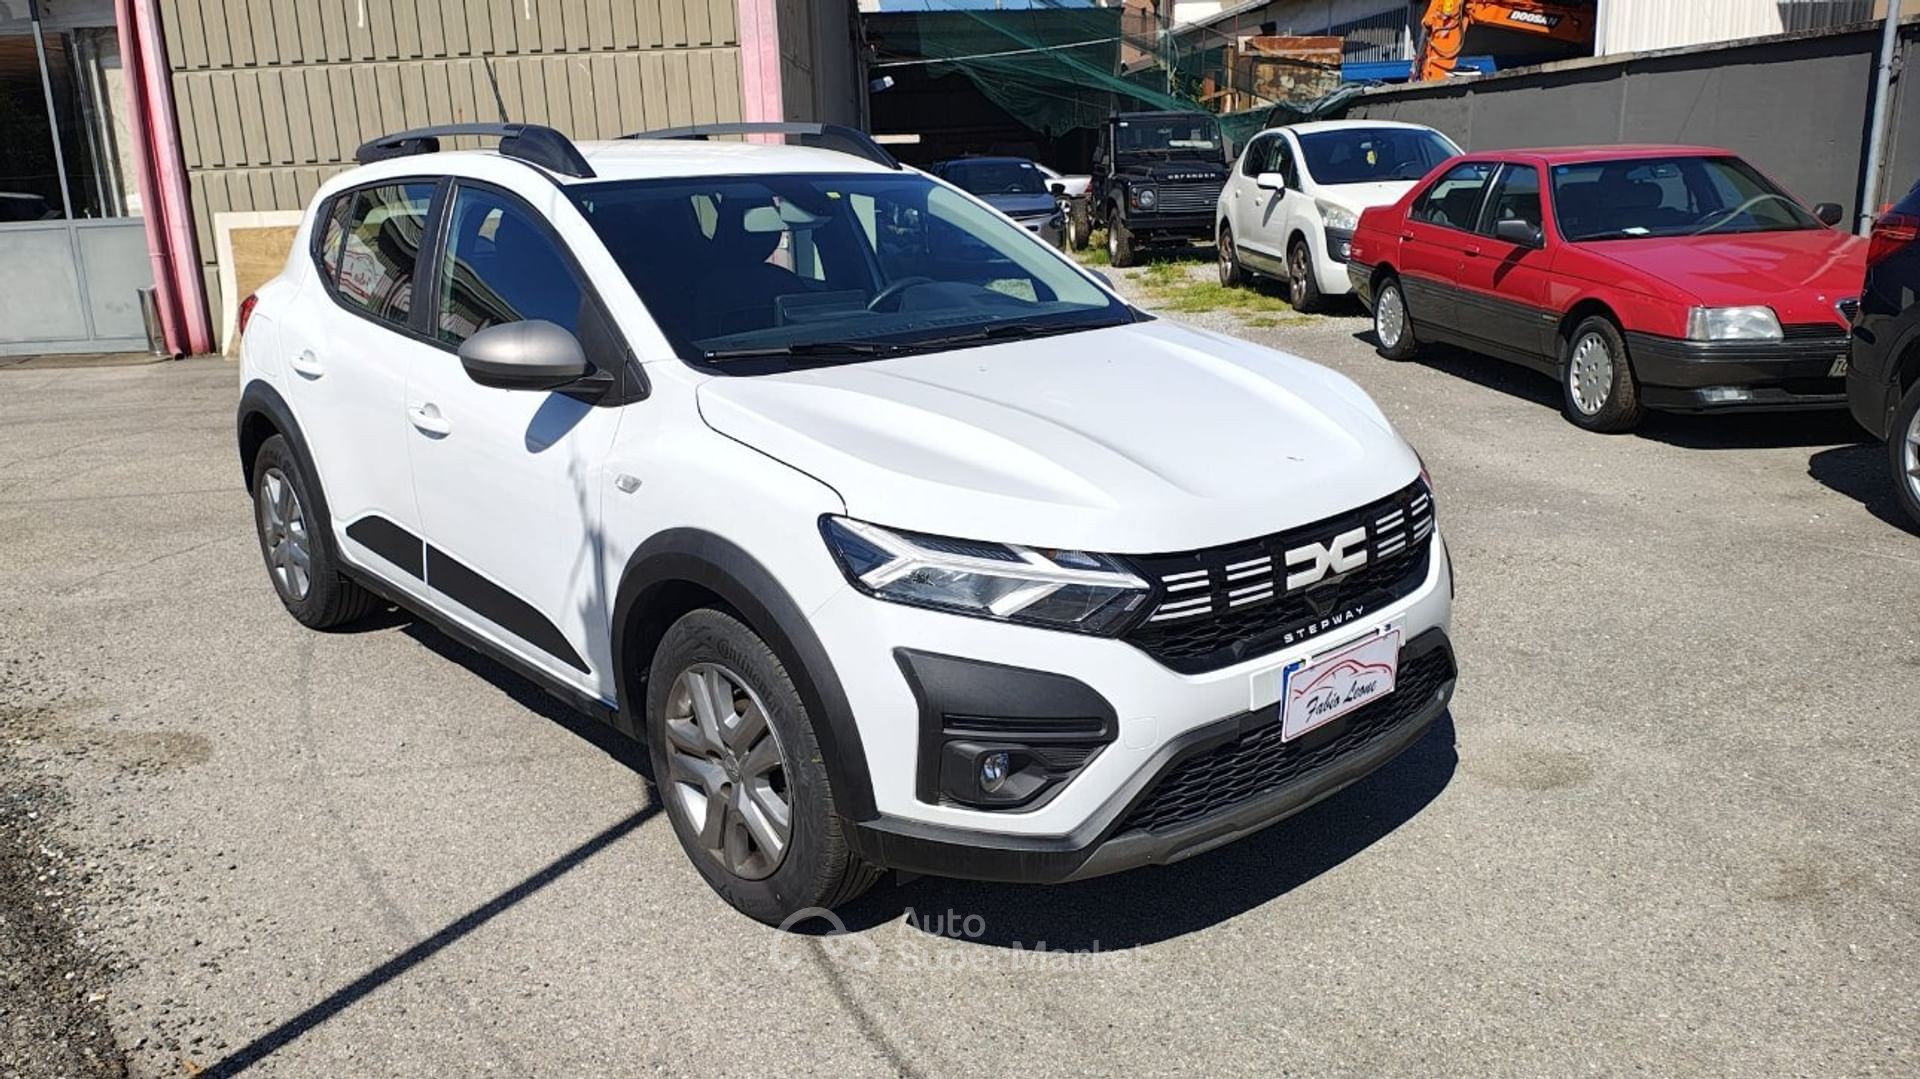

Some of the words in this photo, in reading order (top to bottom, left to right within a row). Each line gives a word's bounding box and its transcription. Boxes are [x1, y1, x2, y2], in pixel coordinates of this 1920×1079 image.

[1510, 10, 1558, 26] DOOSAN
[1168, 172, 1216, 180] DEFENDER
[1284, 605, 1364, 644] STEPWAY
[1306, 691, 1341, 723] Fabio
[1343, 680, 1378, 703] Leone
